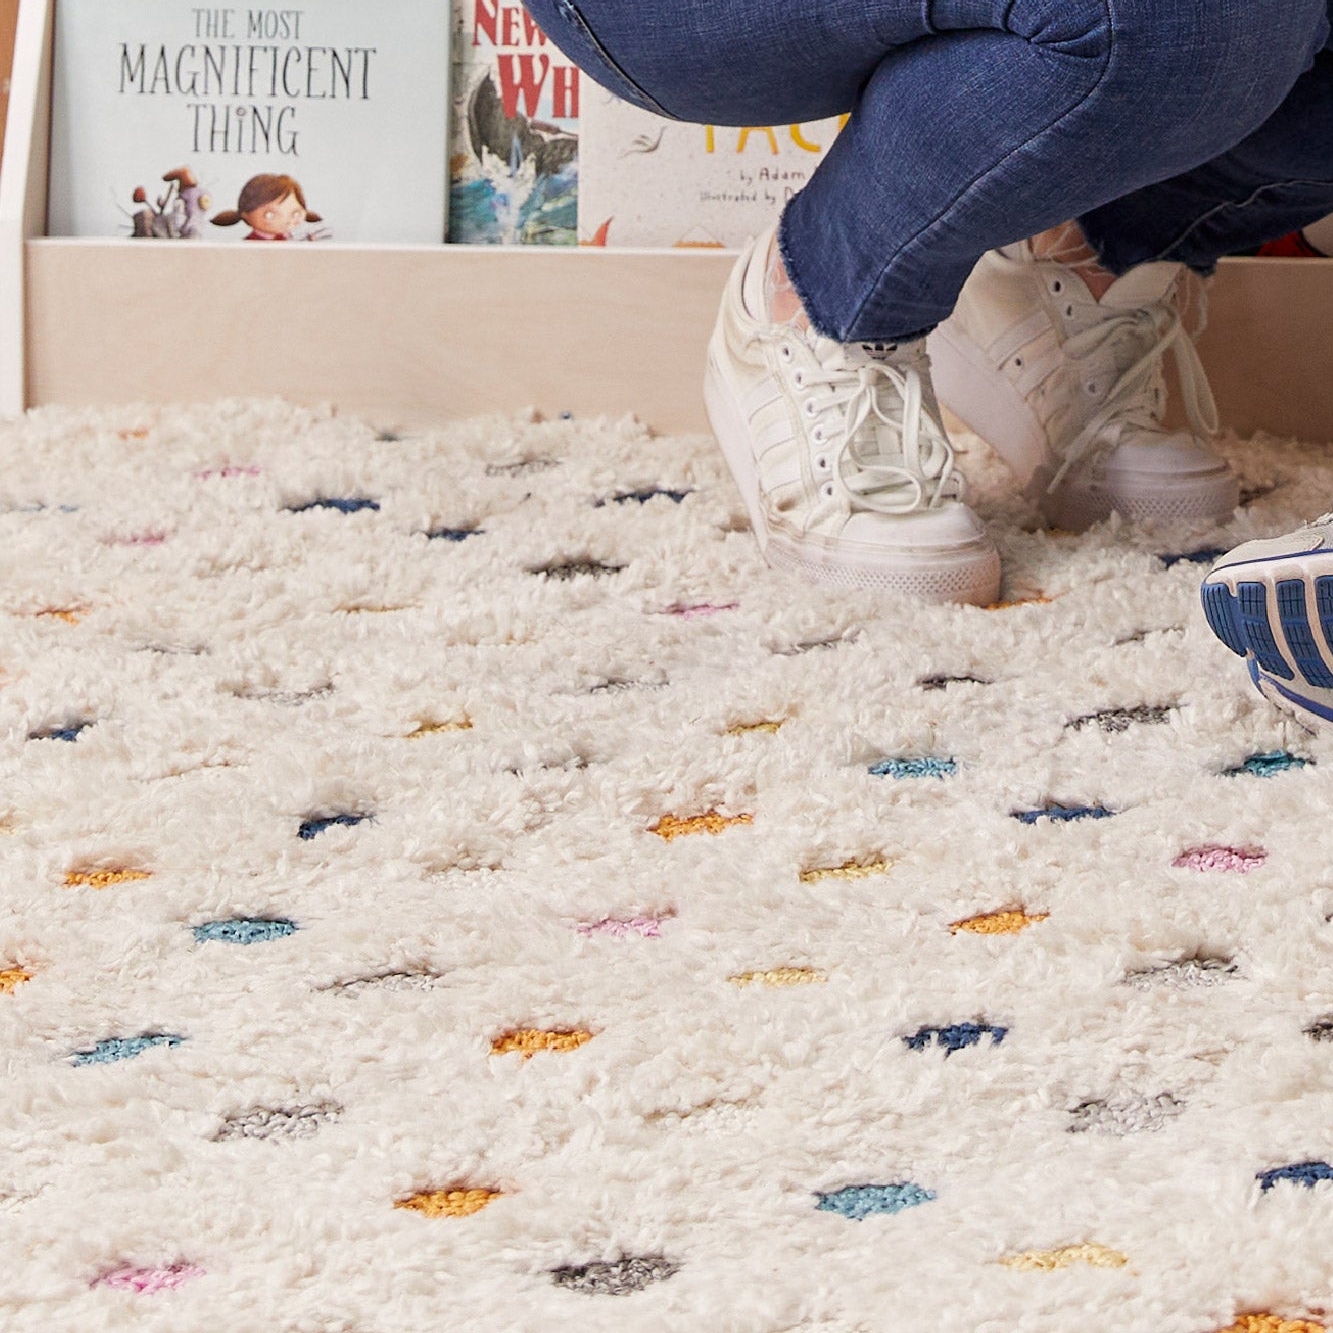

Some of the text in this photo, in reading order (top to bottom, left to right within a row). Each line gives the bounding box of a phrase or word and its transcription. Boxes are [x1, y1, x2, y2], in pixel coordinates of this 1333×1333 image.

[193, 8, 305, 40] THE MOST
[117, 42, 378, 101] MAGNIFICENT
